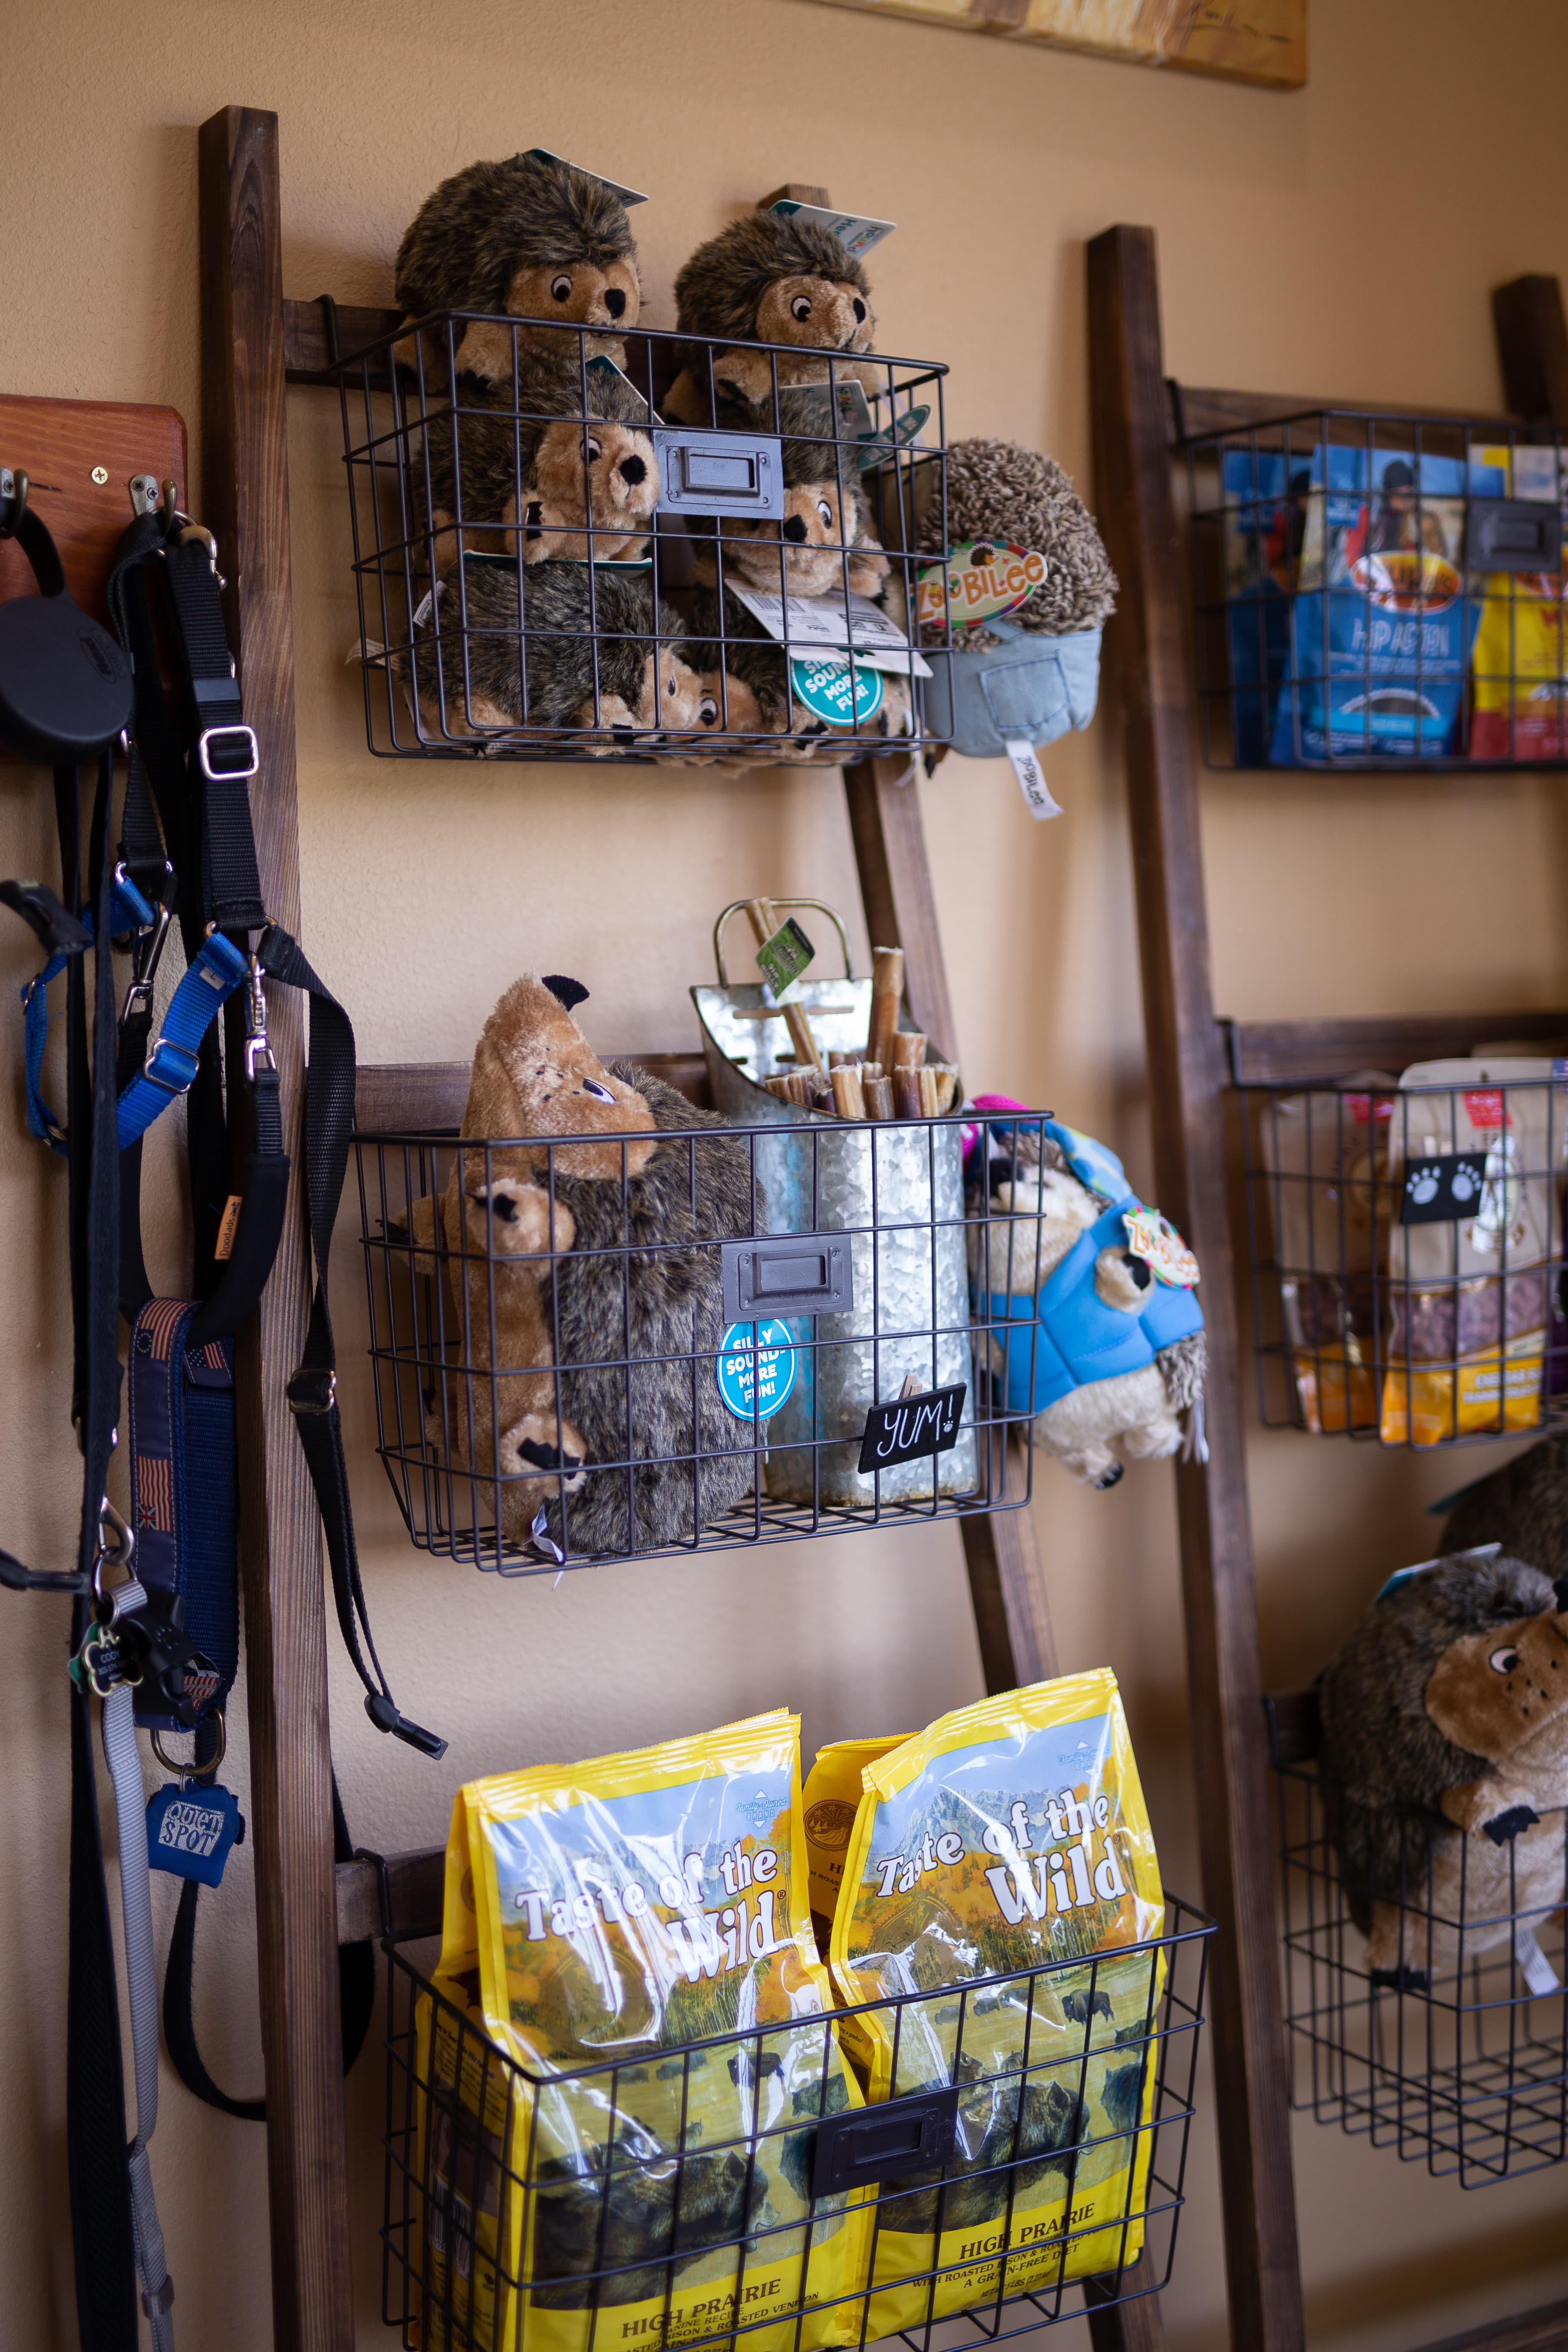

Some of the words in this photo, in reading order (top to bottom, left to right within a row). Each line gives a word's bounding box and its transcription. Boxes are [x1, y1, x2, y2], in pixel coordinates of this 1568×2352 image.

[219, 1218, 235, 1256] Doodads
[732, 1328, 773, 1355] SILLY
[738, 1363, 778, 1389] MORE
[744, 1381, 776, 1404] FUN!
[877, 1393, 953, 1457] YUM!
[735, 1796, 787, 1814] Family-Owned
[747, 1809, 775, 1821] BRAND
[161, 1821, 216, 1855] SPOT
[876, 1831, 965, 1897] Taste
[982, 1801, 1032, 1856] of
[1044, 1788, 1110, 1841] the
[516, 1881, 649, 1941] Taste
[658, 1852, 705, 1909] of
[719, 1840, 778, 1895] the
[818, 1873, 841, 1886] ROAS
[984, 1835, 1127, 1926] Wild
[666, 1890, 776, 1983] Wild
[959, 2230, 1013, 2260] HIGH
[1019, 2202, 1095, 2243] PRAIRIE
[945, 2263, 994, 2282] ROASTED
[963, 2278, 973, 2288] A
[621, 2308, 684, 2339] HIGH
[692, 2278, 781, 2318] PRAIRIE
